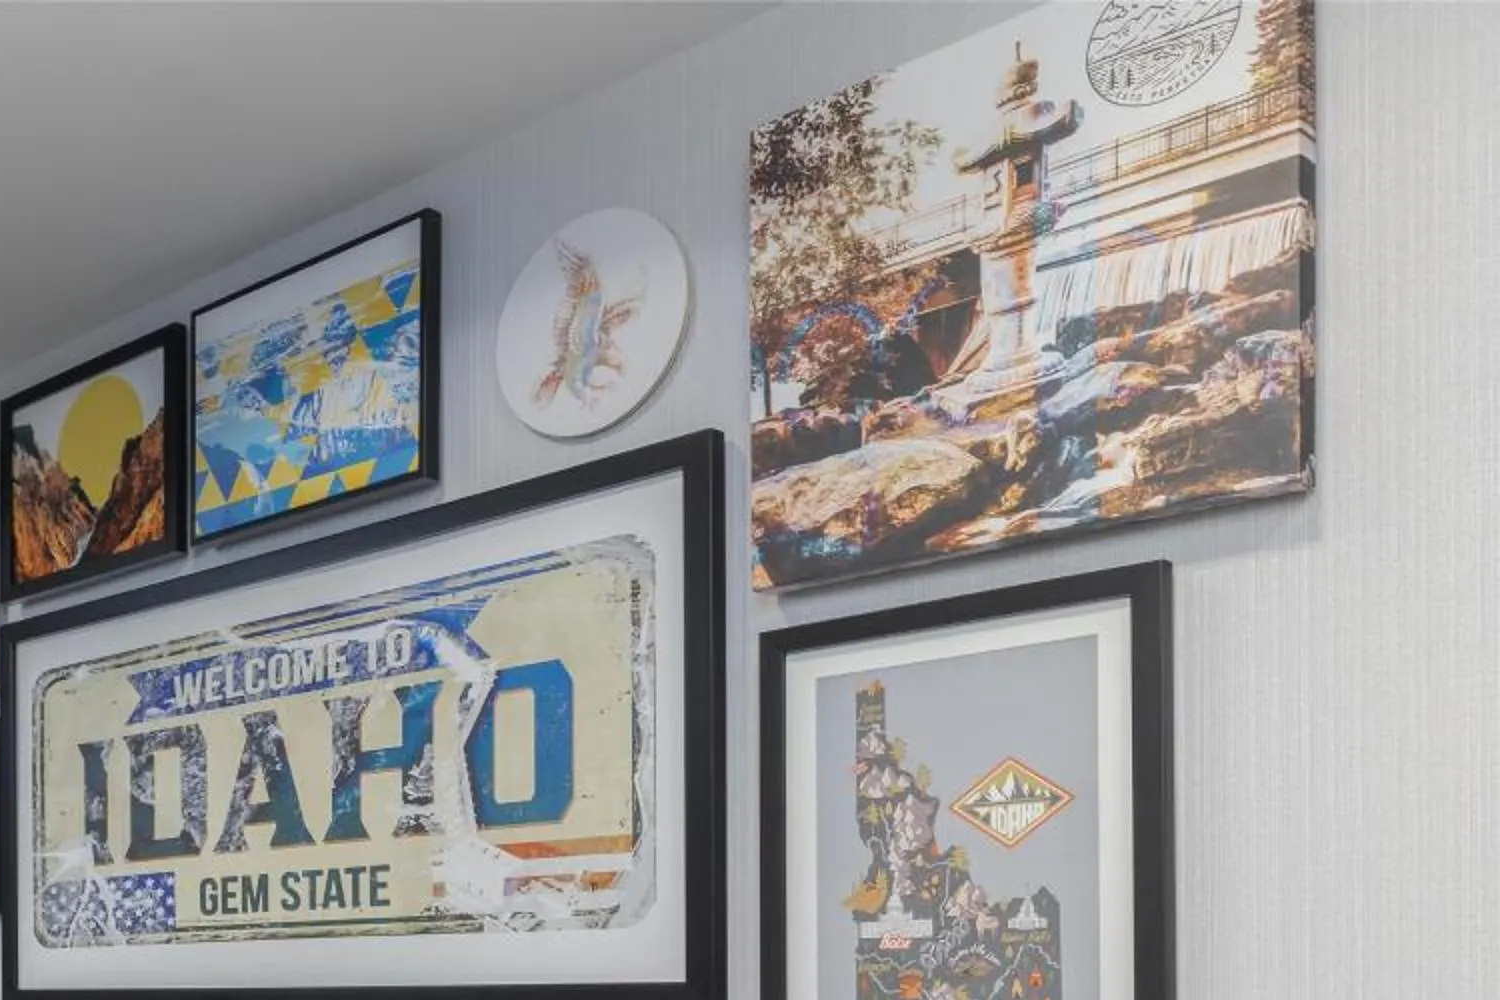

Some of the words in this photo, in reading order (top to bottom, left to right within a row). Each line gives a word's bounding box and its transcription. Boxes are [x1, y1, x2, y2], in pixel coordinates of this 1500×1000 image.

[173, 641, 347, 706] WELCOME
[366, 627, 412, 675] TO
[76, 657, 575, 867] IDAHO
[199, 873, 269, 916] GEM
[280, 864, 391, 912] STATE
